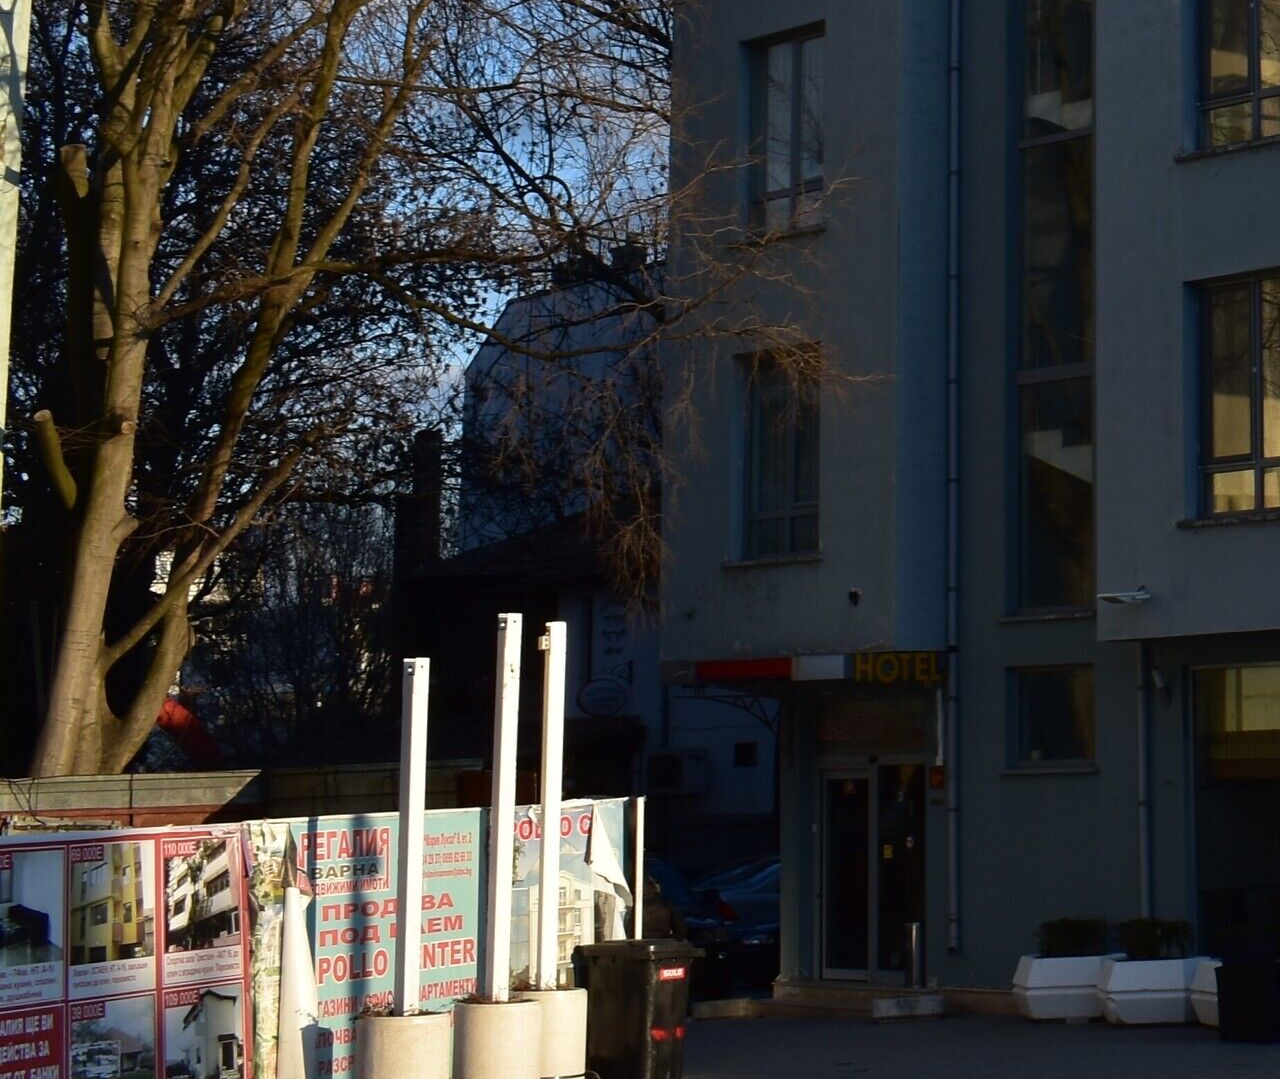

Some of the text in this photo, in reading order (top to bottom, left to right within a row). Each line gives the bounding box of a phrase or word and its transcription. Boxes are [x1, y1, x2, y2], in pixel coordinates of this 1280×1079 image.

[855, 651, 943, 685] HOTEL
[300, 827, 391, 864] РЕГАЛИЯ
[311, 862, 380, 880] ВАРНА
[314, 877, 390, 896] ДВИЖИМИ ИМОТИ
[322, 893, 454, 922] ПРОДВА
[319, 924, 380, 947] ПОД
[318, 939, 476, 985] POLLO NTER
[317, 996, 358, 1018] ГАЗИНИ
[419, 977, 477, 1001] АРТАМЕНТИ
[318, 1055, 355, 1077] РАЗСР
